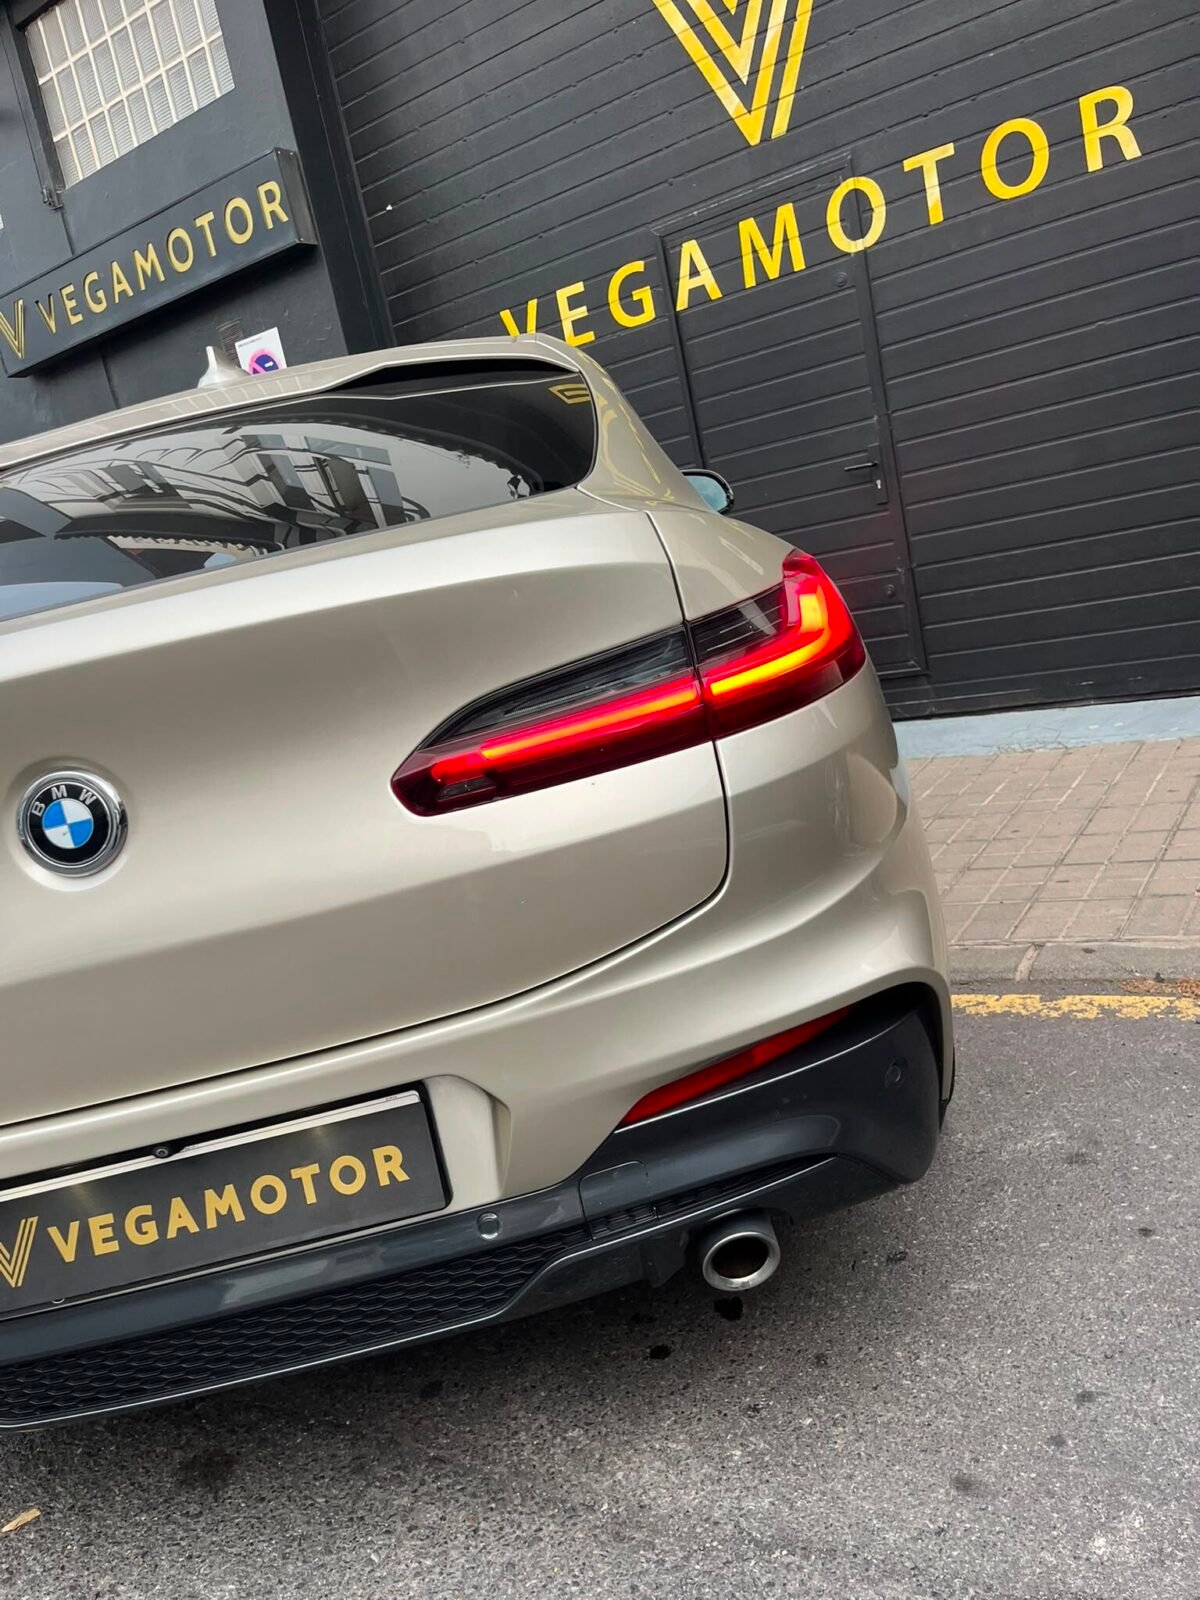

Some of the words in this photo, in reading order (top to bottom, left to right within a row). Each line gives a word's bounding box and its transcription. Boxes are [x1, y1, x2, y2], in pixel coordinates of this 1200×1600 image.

[35, 180, 289, 334] VEGAMOTOR
[499, 85, 1142, 348] VEGAMOTOR
[31, 784, 98, 817] BMW
[47, 1144, 410, 1263] VEGAMOTOR
